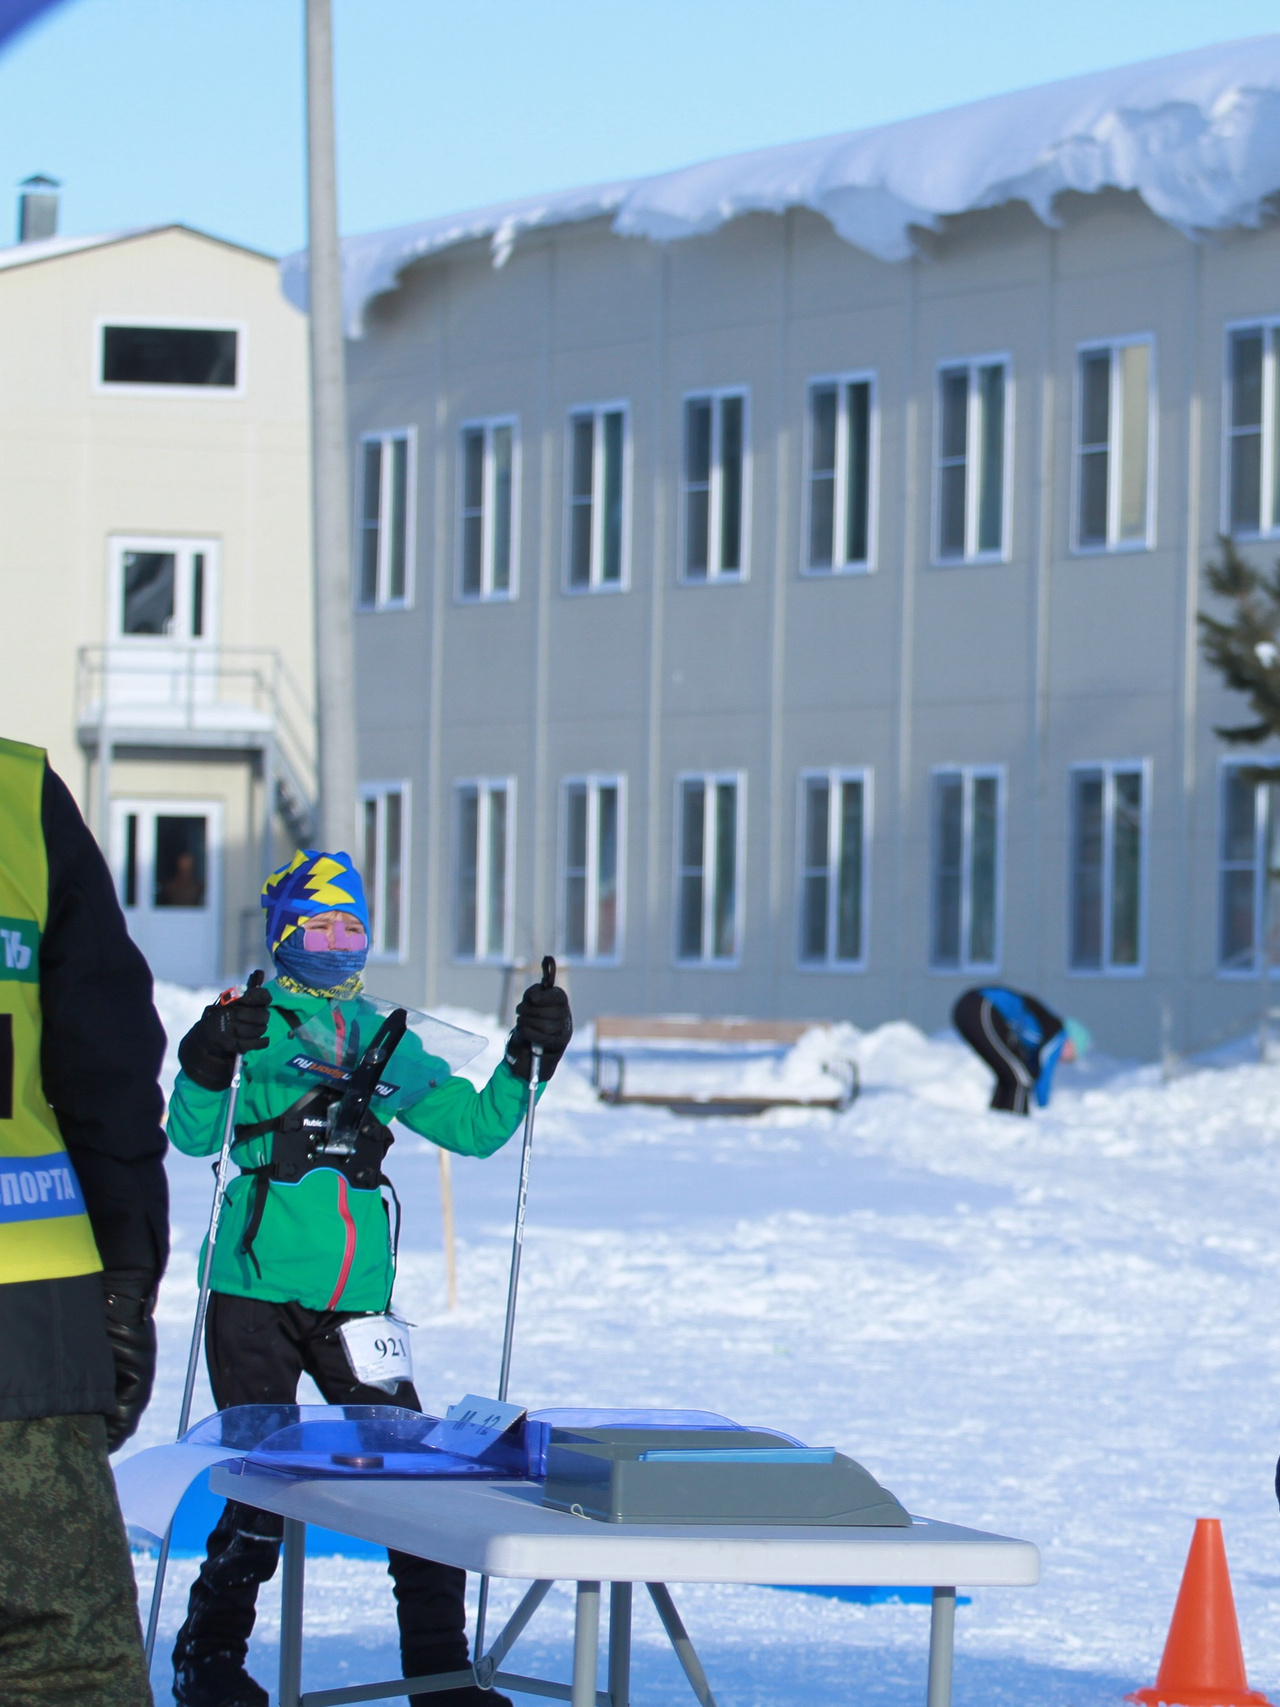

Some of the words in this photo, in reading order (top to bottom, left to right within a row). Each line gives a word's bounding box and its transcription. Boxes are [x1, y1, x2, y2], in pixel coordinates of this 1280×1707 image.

[0, 1168, 76, 1206] ПОРТА
[210, 1144, 229, 1244] FISCHER
[516, 1145, 531, 1244] FISCHER
[374, 1337, 406, 1359] 921
